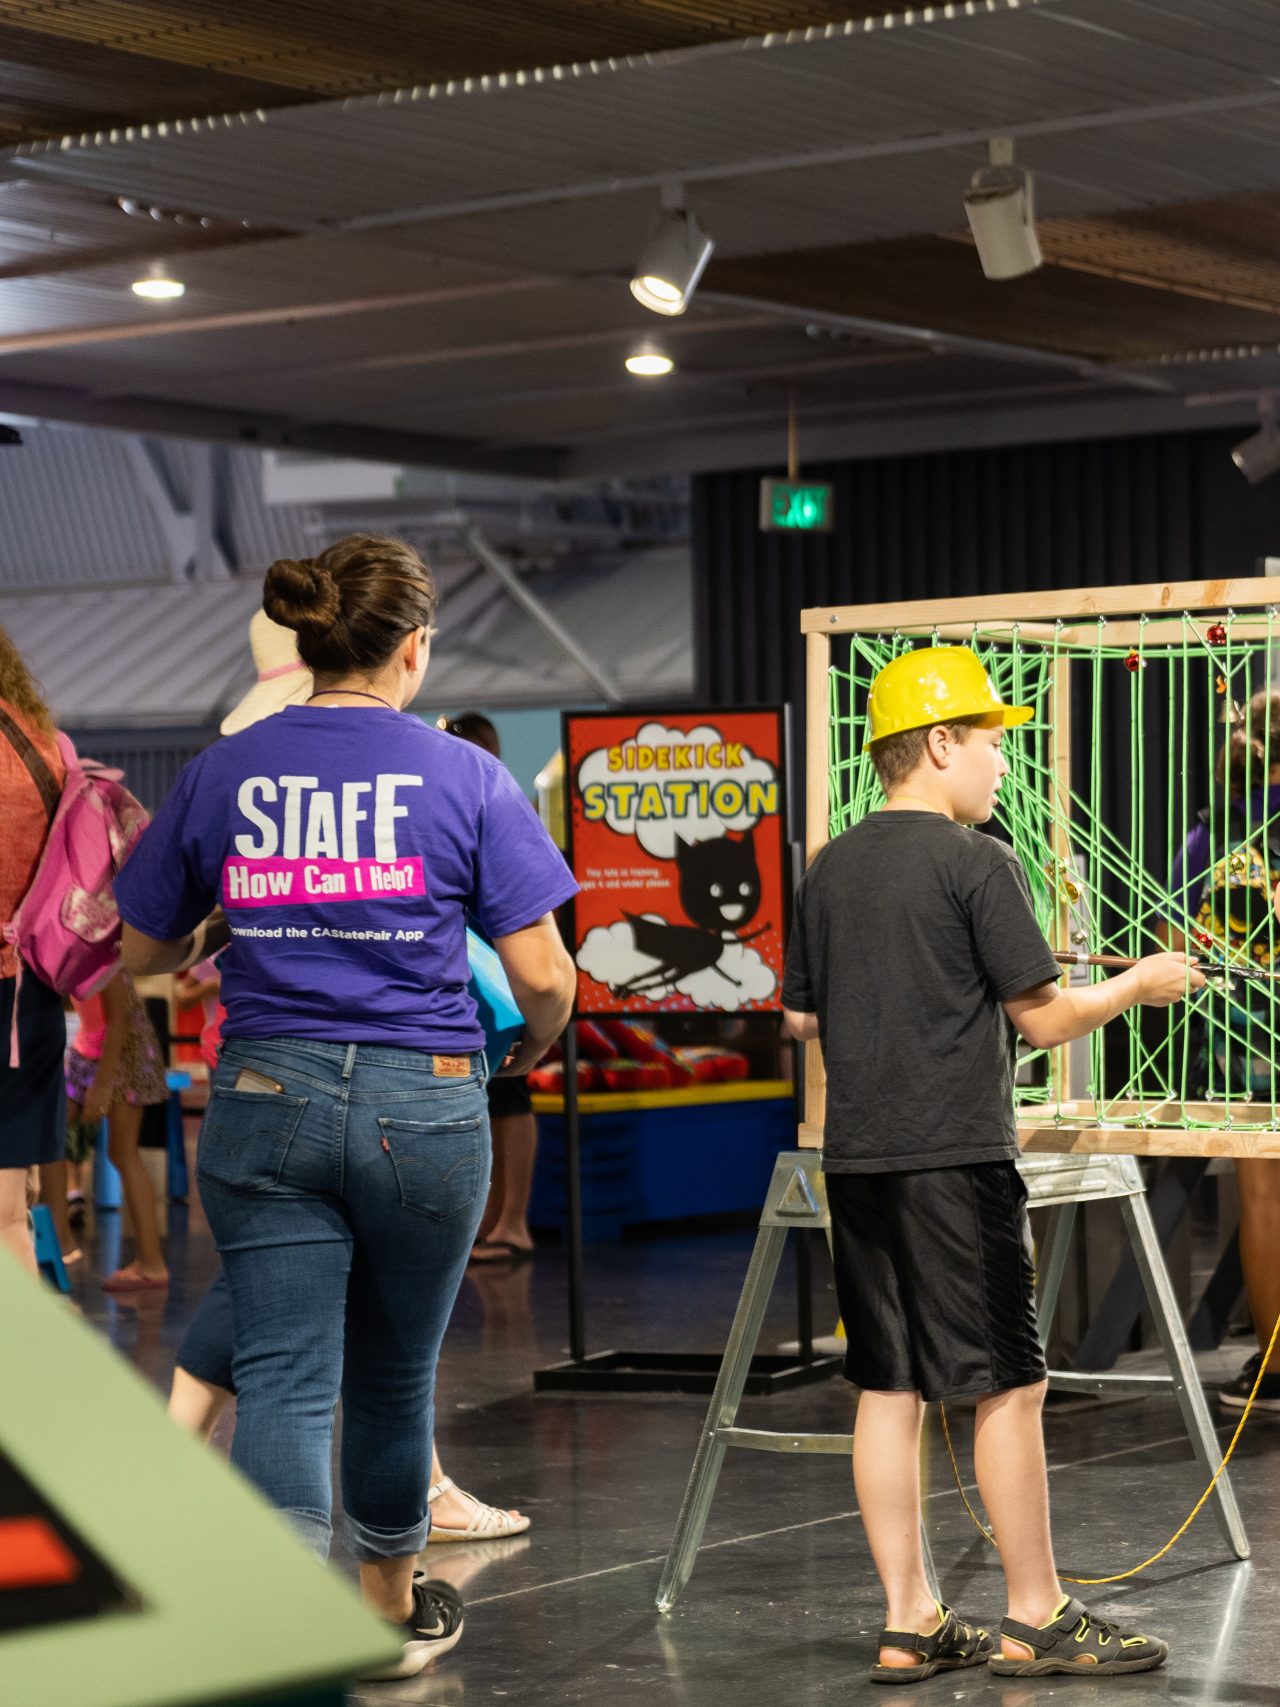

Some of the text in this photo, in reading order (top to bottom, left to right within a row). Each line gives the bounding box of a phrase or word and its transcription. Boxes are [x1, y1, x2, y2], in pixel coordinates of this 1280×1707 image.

[607, 742, 744, 772] SIDEKICK
[583, 779, 779, 820] STATION
[234, 773, 424, 863] STAFF
[228, 864, 414, 899] How Can I Help?
[286, 926, 307, 939] the
[311, 927, 392, 941] CAStateFair
[394, 930, 425, 942] App
